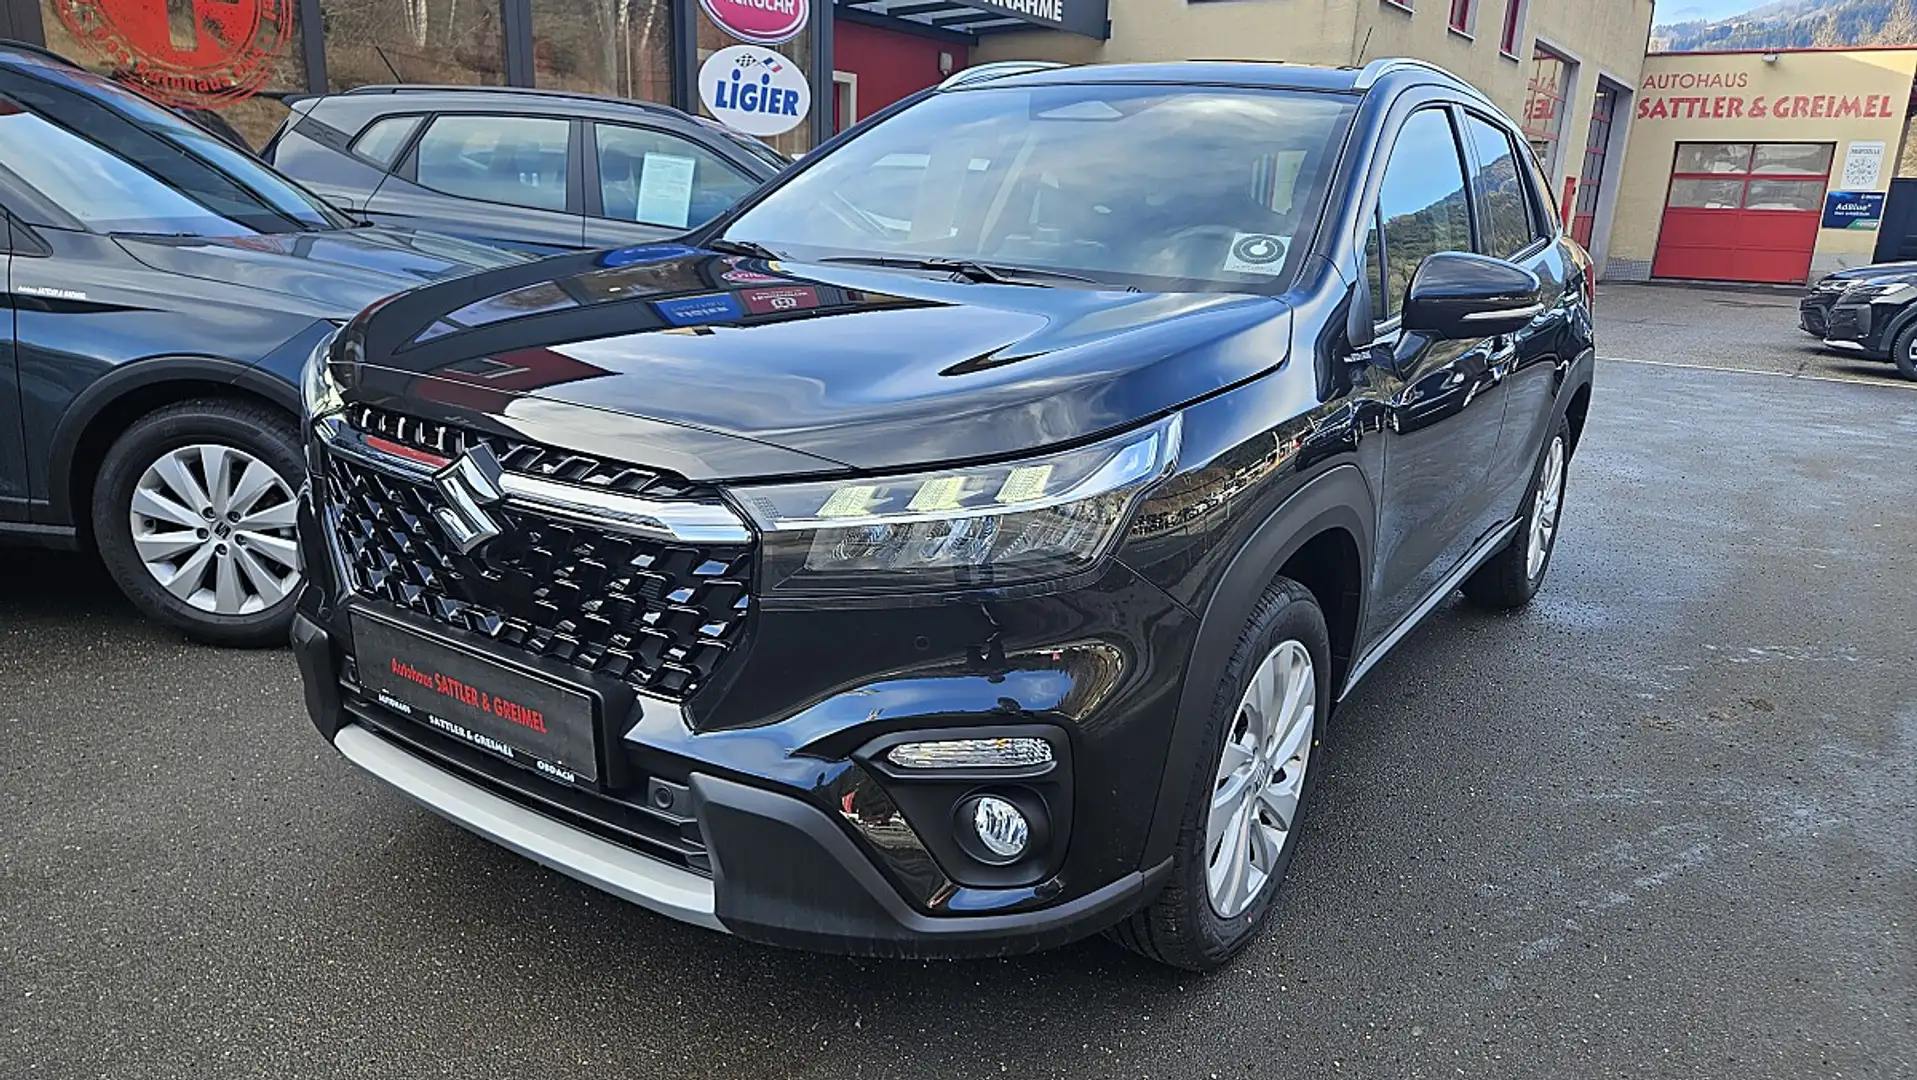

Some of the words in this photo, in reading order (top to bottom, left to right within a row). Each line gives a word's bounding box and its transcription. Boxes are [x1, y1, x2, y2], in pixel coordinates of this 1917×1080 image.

[1643, 73, 1748, 90] AUTOHAUS
[1637, 96, 1743, 119] SATTLER
[1748, 97, 1768, 119] &
[1772, 95, 1893, 119] GREIMEL
[391, 658, 433, 688] Autohaus
[434, 672, 479, 708] SATTLER
[481, 692, 491, 712] &
[493, 697, 548, 735] GREIMEL
[429, 714, 466, 738] SATTLER
[474, 733, 515, 758] GREIMEL
